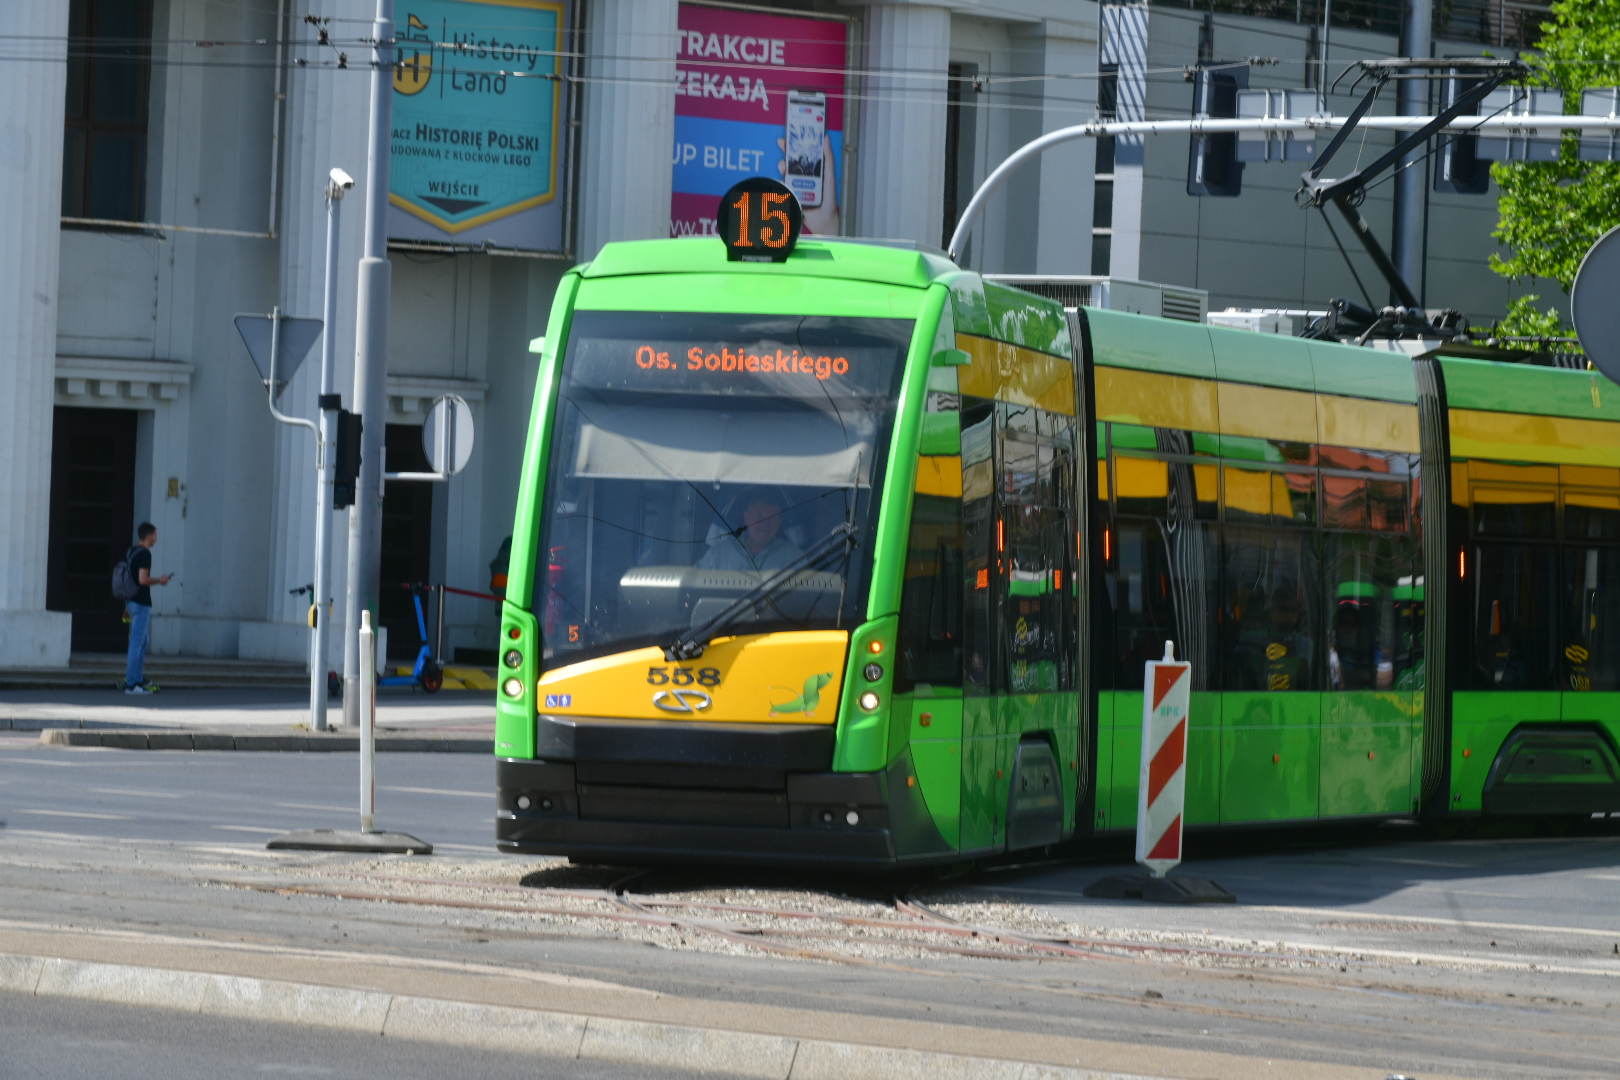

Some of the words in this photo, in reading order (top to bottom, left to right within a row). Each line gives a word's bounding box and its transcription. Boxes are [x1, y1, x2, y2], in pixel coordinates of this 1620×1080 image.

[454, 32, 539, 71] History
[676, 29, 785, 65] TRAKCJE
[451, 66, 507, 95] Land
[674, 69, 770, 111] ZEKAJĄ
[391, 128, 411, 140] ACZ
[487, 130, 539, 152] POLSKI
[503, 154, 531, 167] LEGO
[704, 145, 764, 172] BILET
[428, 180, 480, 197] WEJŚCIE
[733, 191, 791, 248] 15
[635, 345, 677, 370] Os.
[687, 346, 849, 380] Sobieskiego
[646, 665, 721, 687] 558
[1160, 705, 1180, 717] MPK
